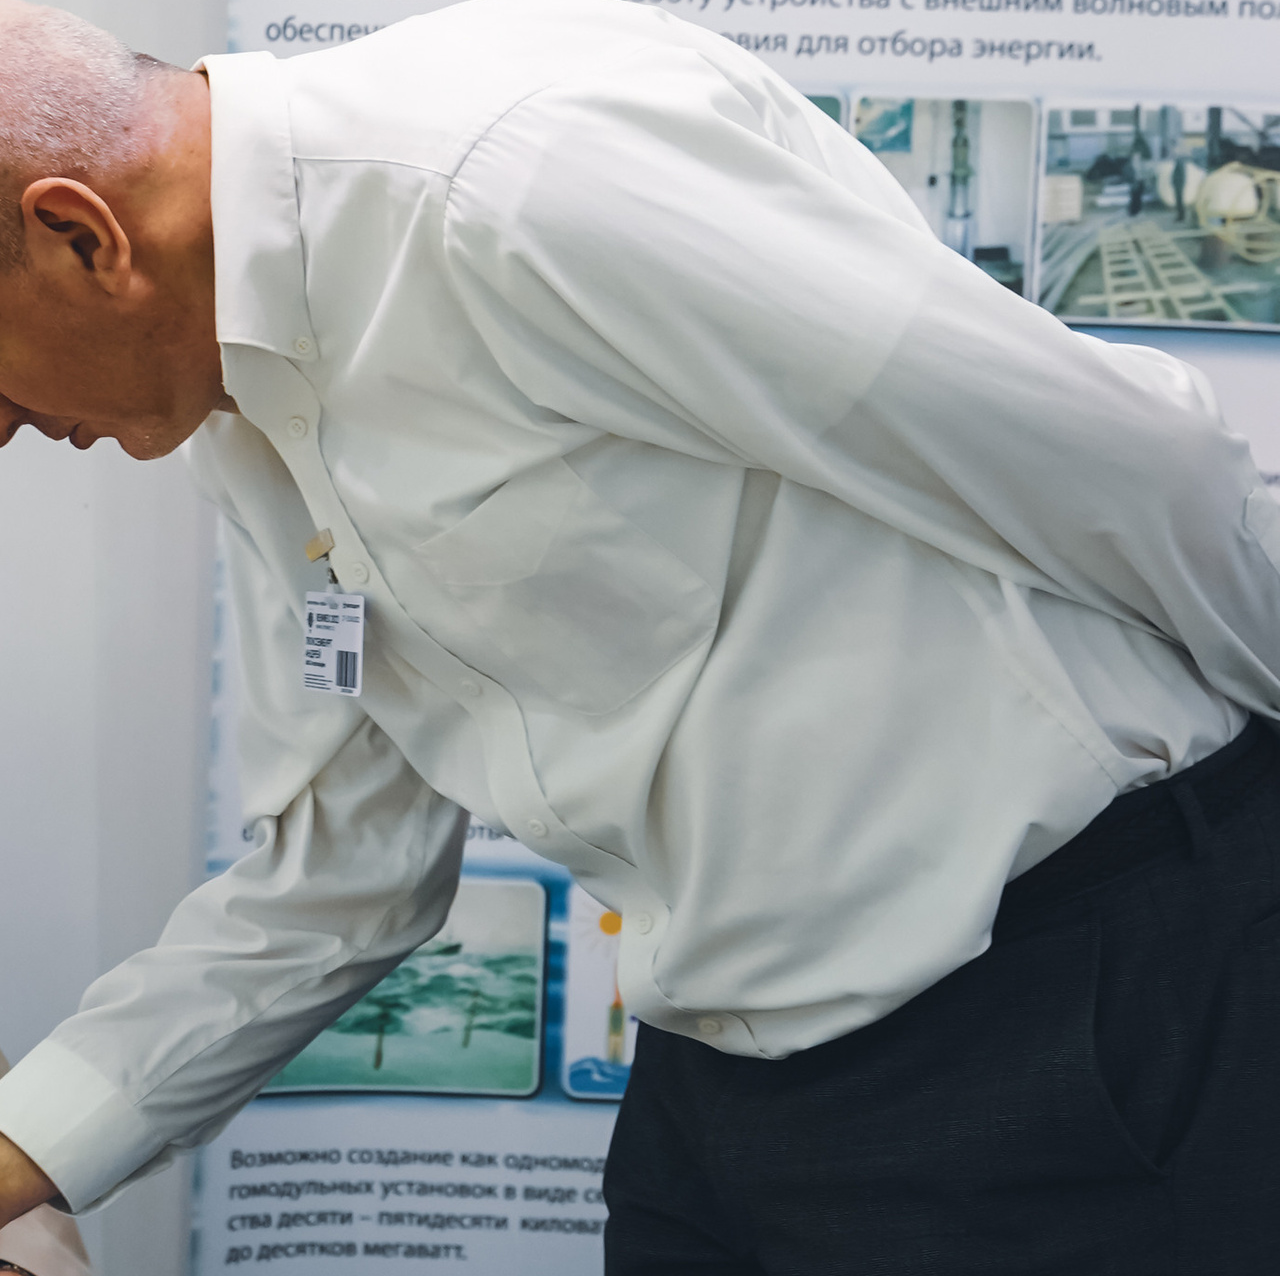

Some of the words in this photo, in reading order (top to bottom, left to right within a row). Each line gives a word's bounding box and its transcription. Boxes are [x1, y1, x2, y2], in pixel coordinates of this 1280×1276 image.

[795, 33, 849, 58] для
[858, 30, 963, 59] отбора
[970, 37, 1102, 64] энергии.
[230, 1149, 342, 1170] Возможно
[347, 1149, 454, 1168] создание
[460, 1152, 499, 1168] как
[228, 1179, 375, 1201] гомодульных
[380, 1179, 498, 1200] установок
[503, 1184, 517, 1200] в
[523, 1184, 578, 1204] виде
[227, 1212, 273, 1232] ства
[277, 1209, 354, 1229] десяти
[378, 1210, 509, 1231] пятидесяти
[225, 1246, 252, 1265] до
[256, 1242, 357, 1262] десятков
[363, 1242, 468, 1260] мегаватт.
